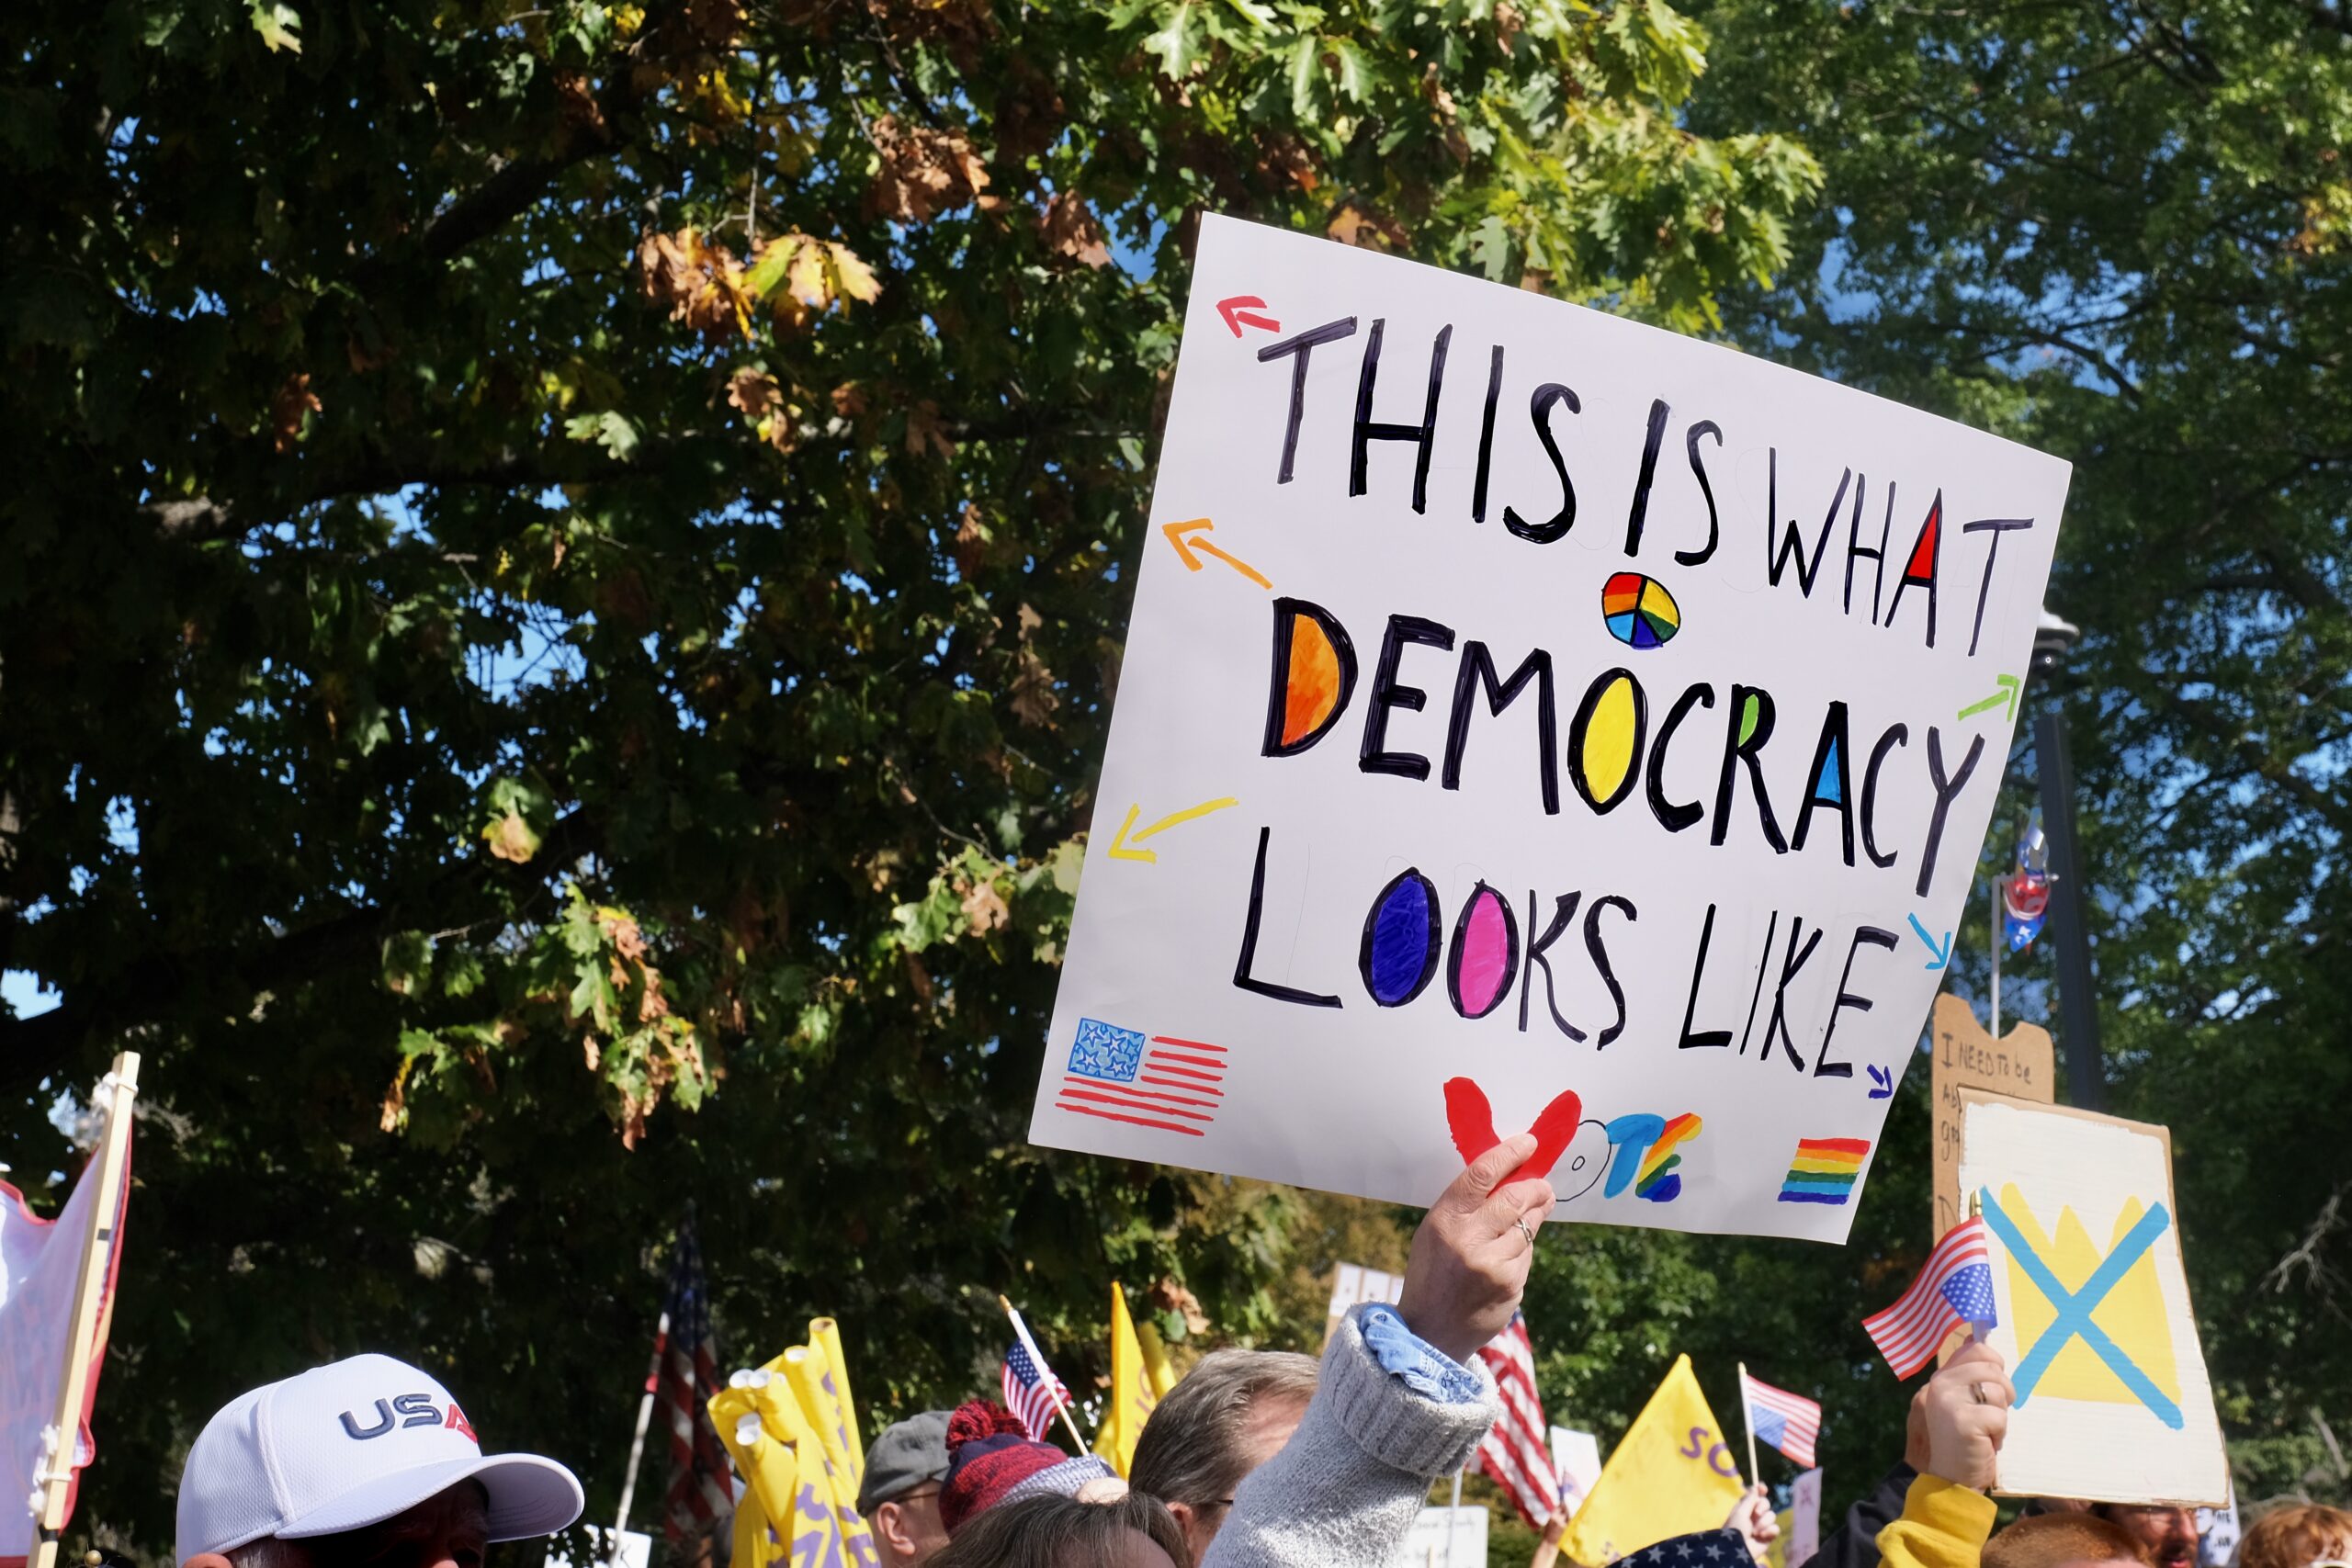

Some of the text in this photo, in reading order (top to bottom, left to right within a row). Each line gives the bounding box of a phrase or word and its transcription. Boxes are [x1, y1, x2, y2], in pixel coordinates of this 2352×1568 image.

[1257, 315, 2035, 657] THIS IS WHAT
[1261, 596, 1985, 897] DEMOCRACY
[1232, 825, 1901, 1078] LOOKS LIKE
[1941, 1032, 1953, 1069] I
[1958, 1041, 1996, 1077] NEED
[338, 1393, 478, 1445] USA
